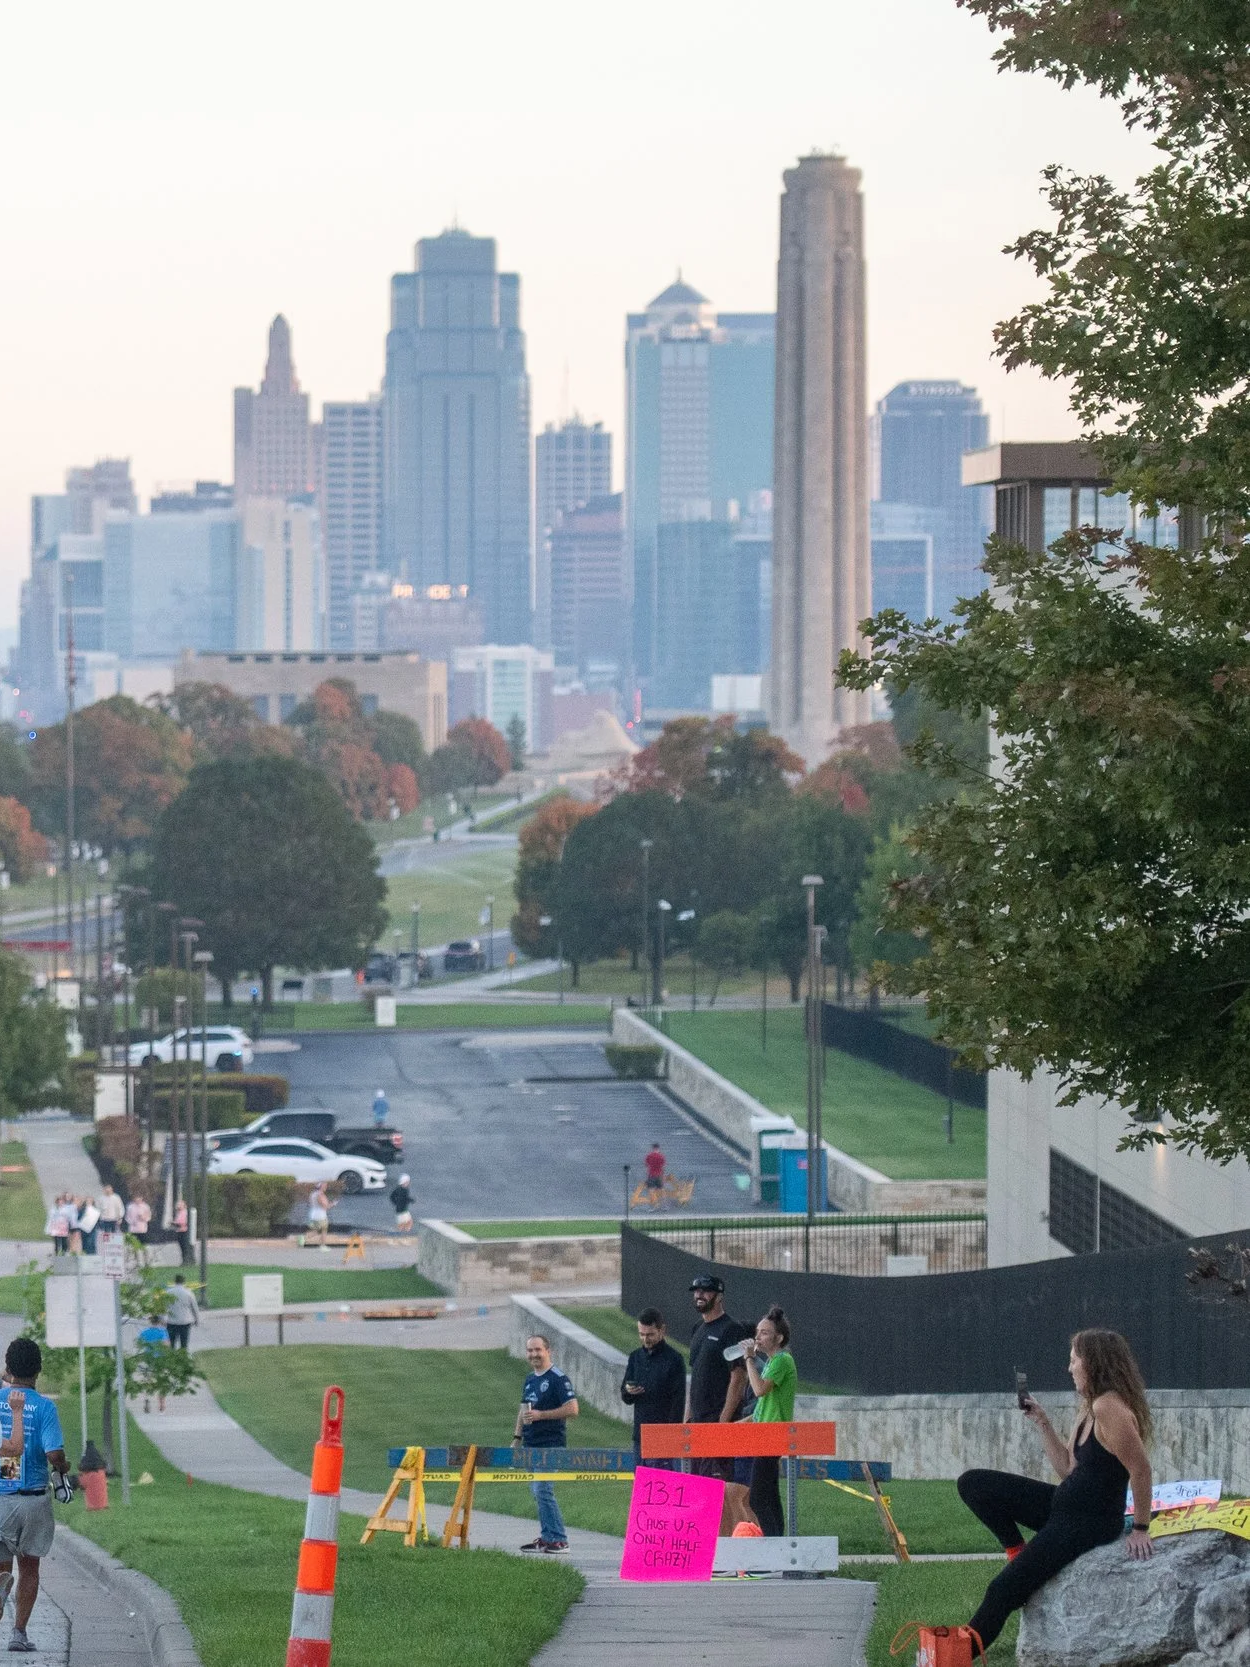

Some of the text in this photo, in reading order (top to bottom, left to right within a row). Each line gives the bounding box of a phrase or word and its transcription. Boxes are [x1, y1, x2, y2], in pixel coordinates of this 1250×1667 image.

[0, 1402, 12, 1410] TO
[633, 1532, 702, 1553] ONLY HALF
[644, 1549, 691, 1569] CRAZY!
